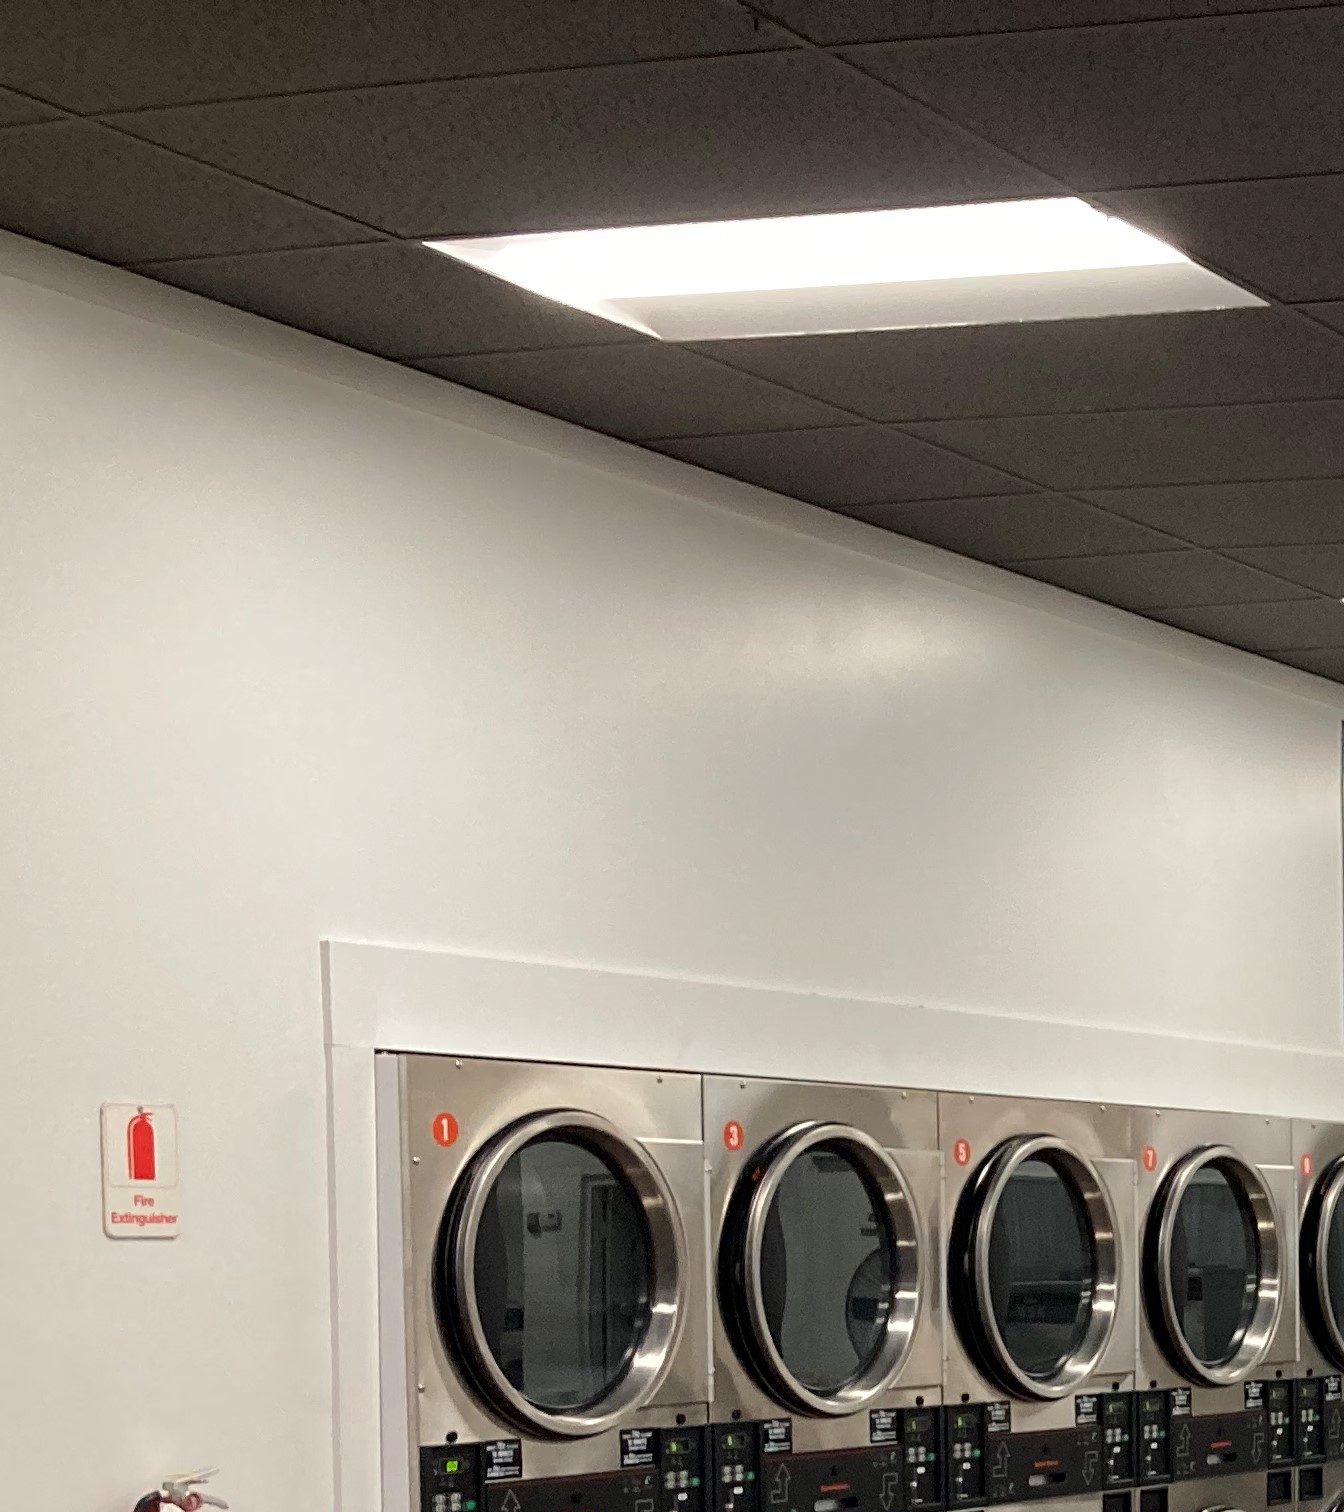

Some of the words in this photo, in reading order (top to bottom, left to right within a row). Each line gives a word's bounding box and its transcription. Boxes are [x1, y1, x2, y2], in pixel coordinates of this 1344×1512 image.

[441, 1117, 450, 1141] 1
[729, 1125, 739, 1147] 3
[958, 1142, 967, 1162] 5
[134, 1194, 155, 1207] Fire
[111, 1211, 178, 1227] Extinguisher
